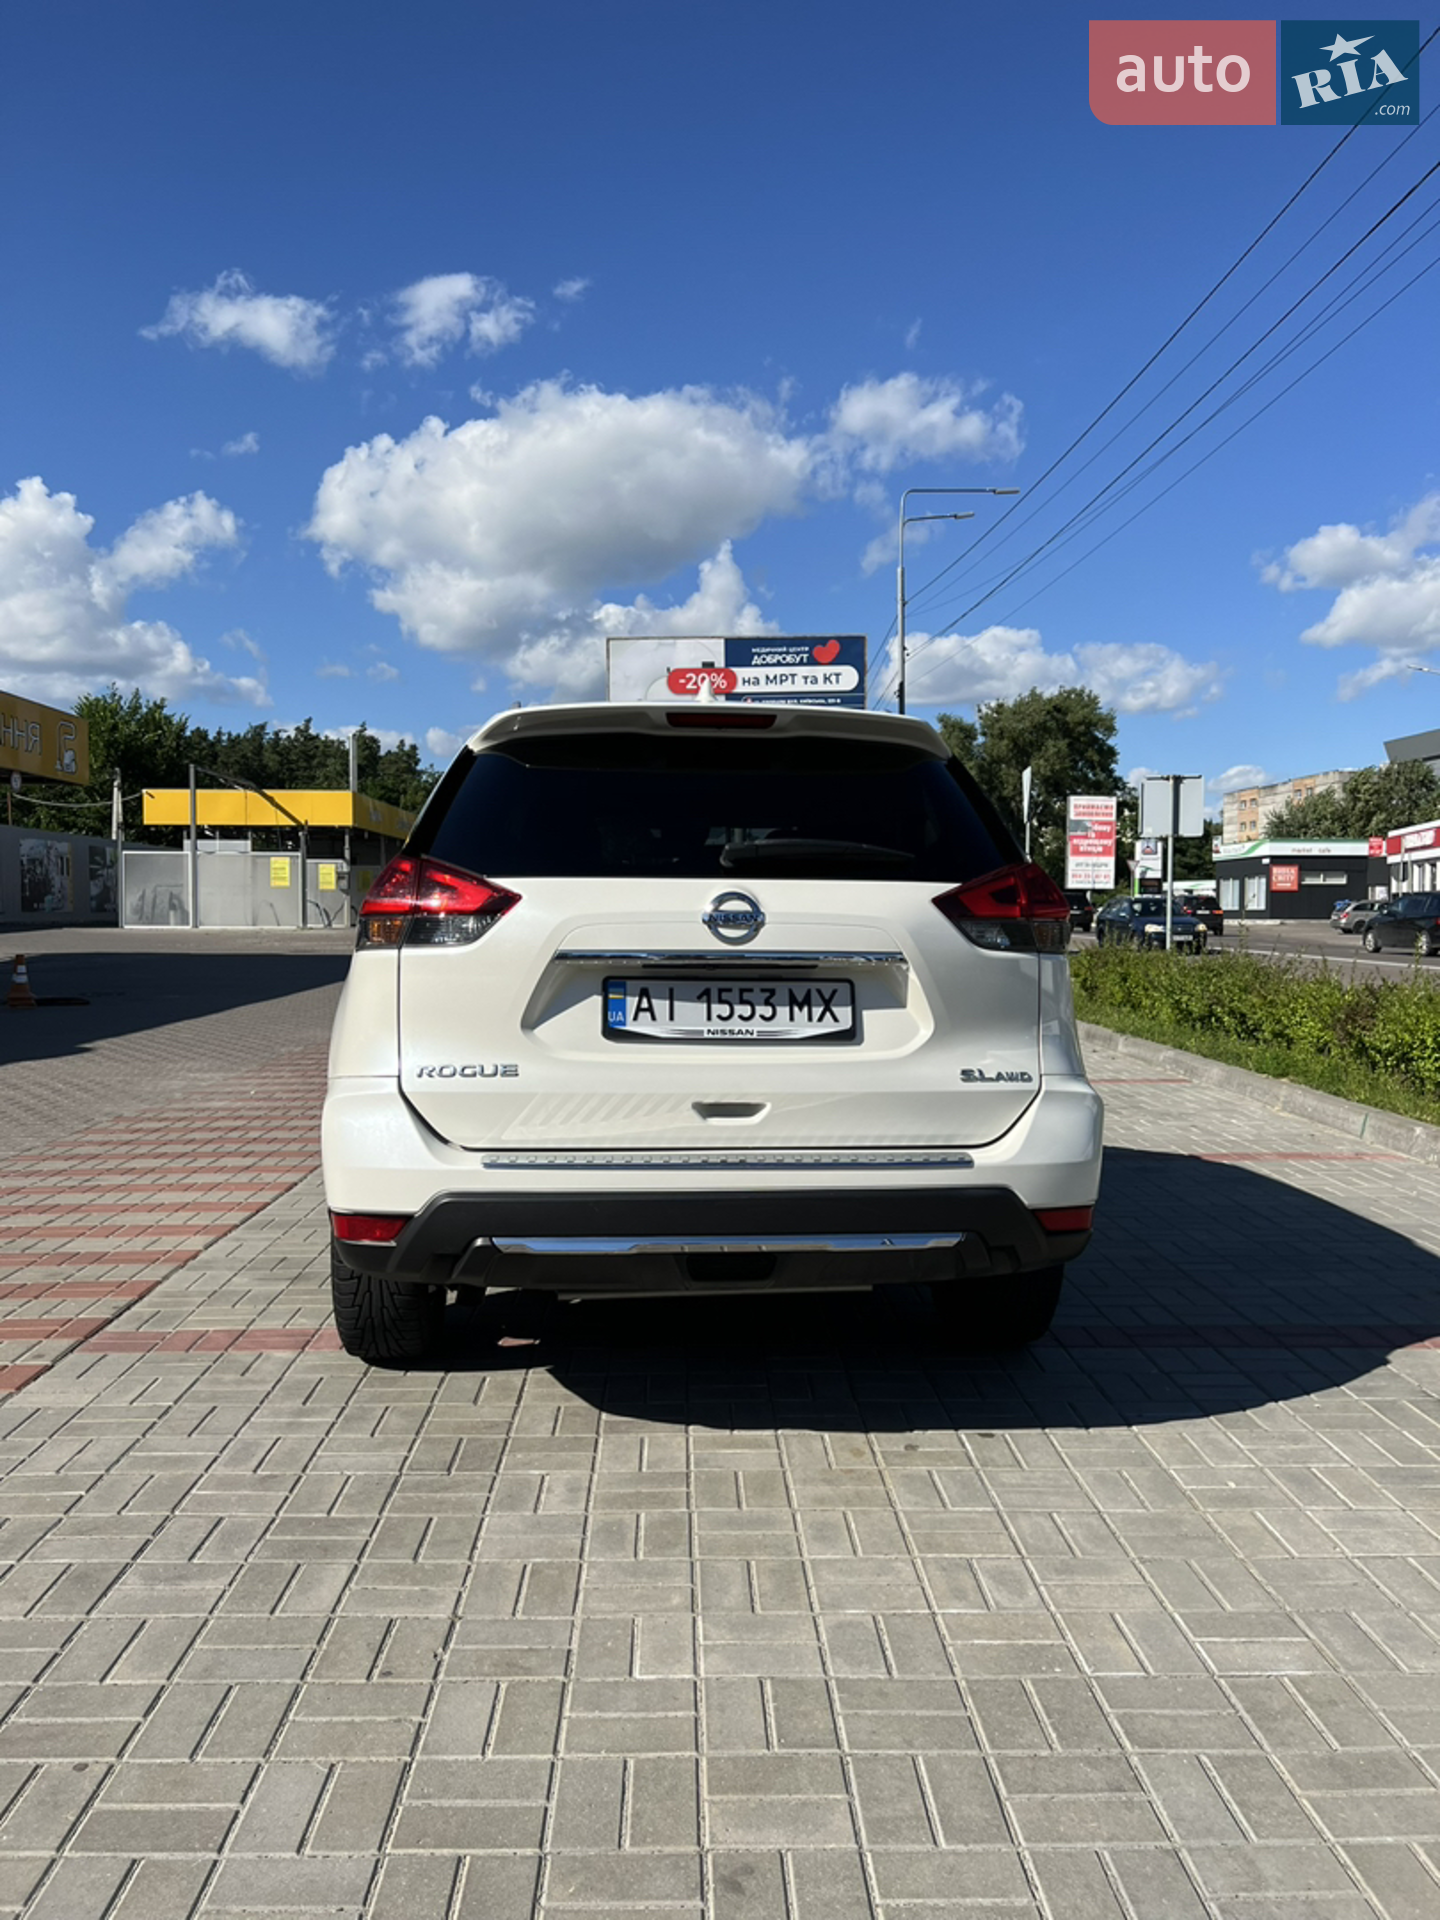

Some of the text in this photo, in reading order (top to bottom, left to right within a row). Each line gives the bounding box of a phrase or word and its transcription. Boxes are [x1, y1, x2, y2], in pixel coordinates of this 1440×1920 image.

[751, 654, 809, 665] ДОБРОБУТ
[742, 677, 760, 686] на
[765, 674, 797, 687] МРТ
[801, 675, 818, 686] та
[822, 672, 842, 686] КТ
[708, 913, 759, 923] NISSAN
[608, 987, 840, 1022] UA AI 1553 MX
[706, 1028, 755, 1036] NISSAN
[416, 1064, 519, 1078] ROGUE
